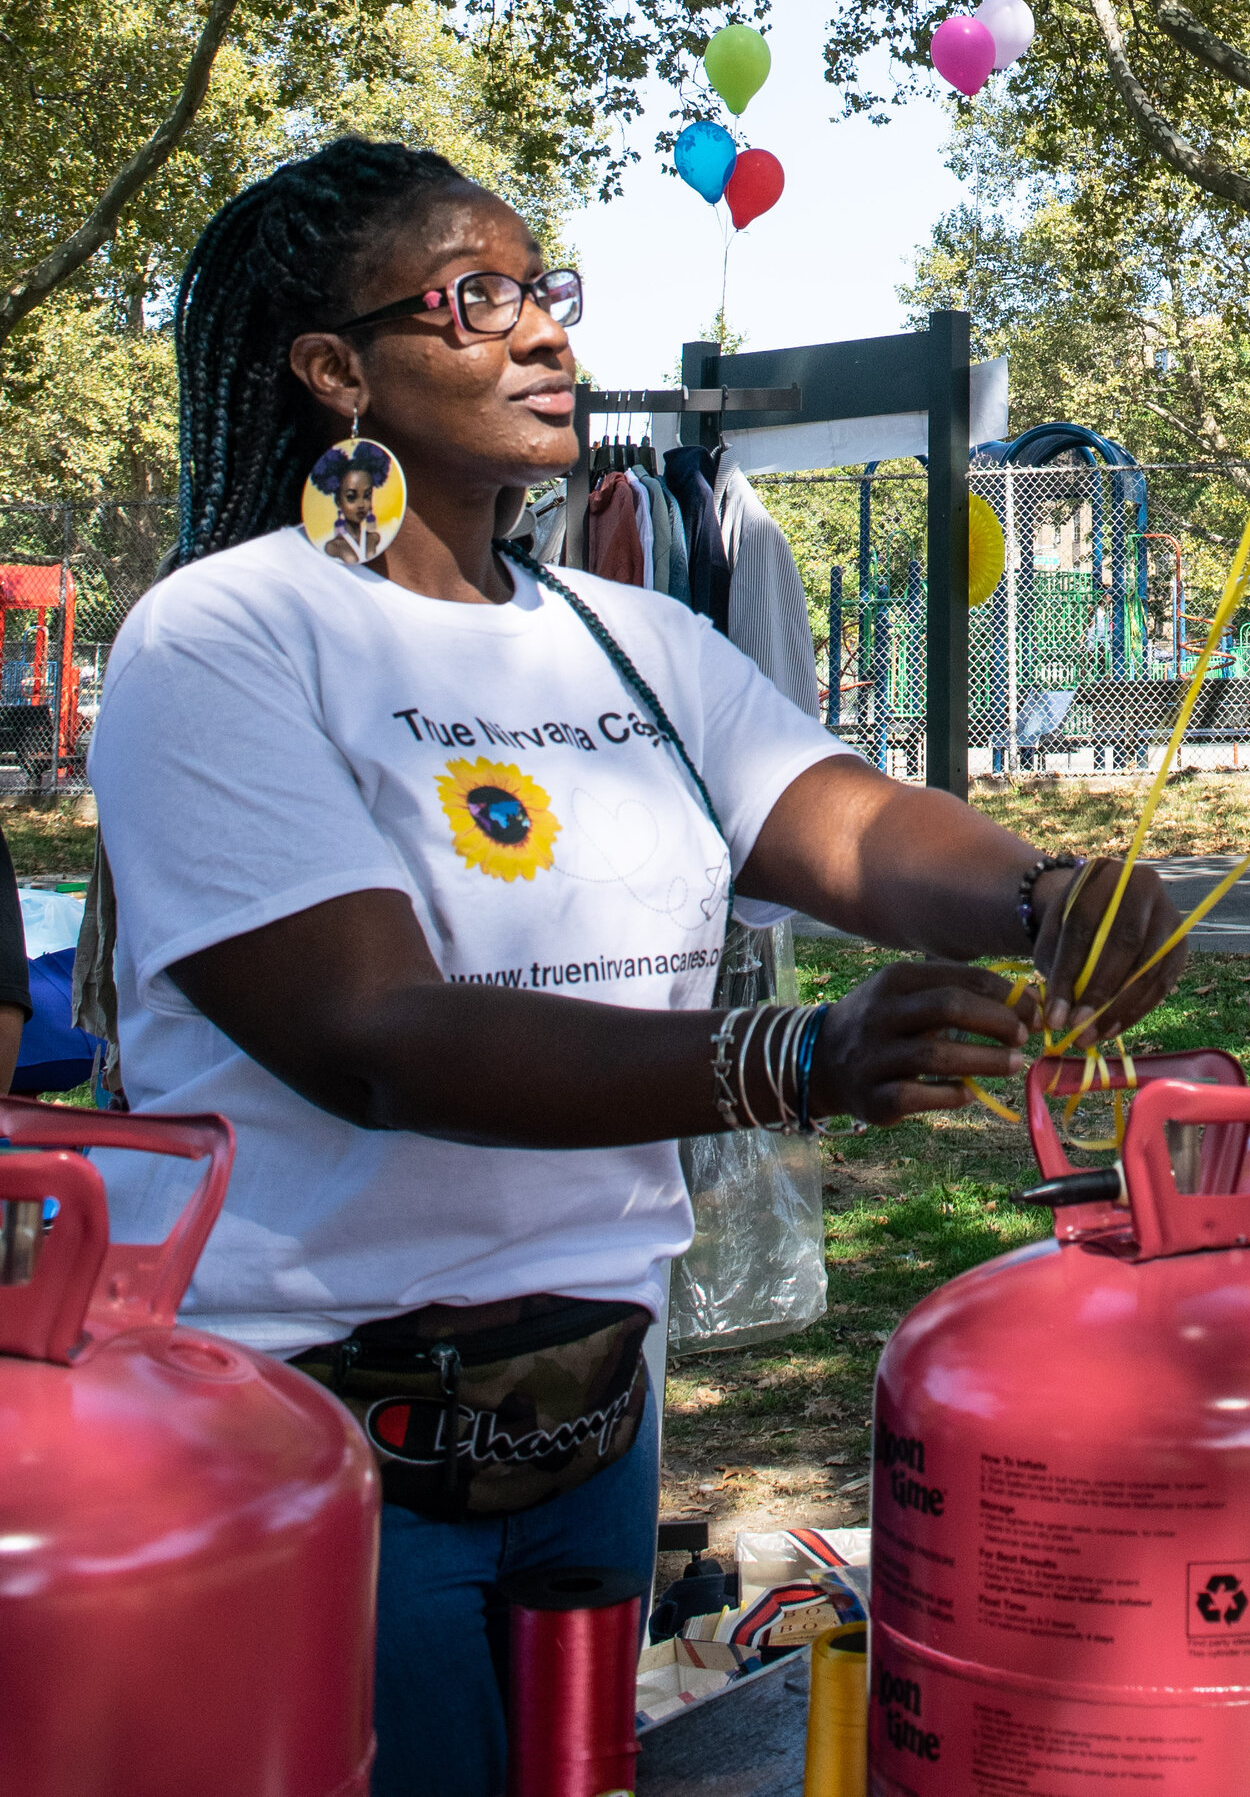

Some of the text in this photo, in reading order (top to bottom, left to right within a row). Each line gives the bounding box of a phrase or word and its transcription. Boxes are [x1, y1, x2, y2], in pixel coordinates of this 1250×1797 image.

[393, 707, 476, 748] True
[476, 717, 598, 752] Nirvana
[450, 947, 722, 989] www.truenirvanacares.o
[891, 1468, 944, 1517] time
[886, 1708, 941, 1762] time
